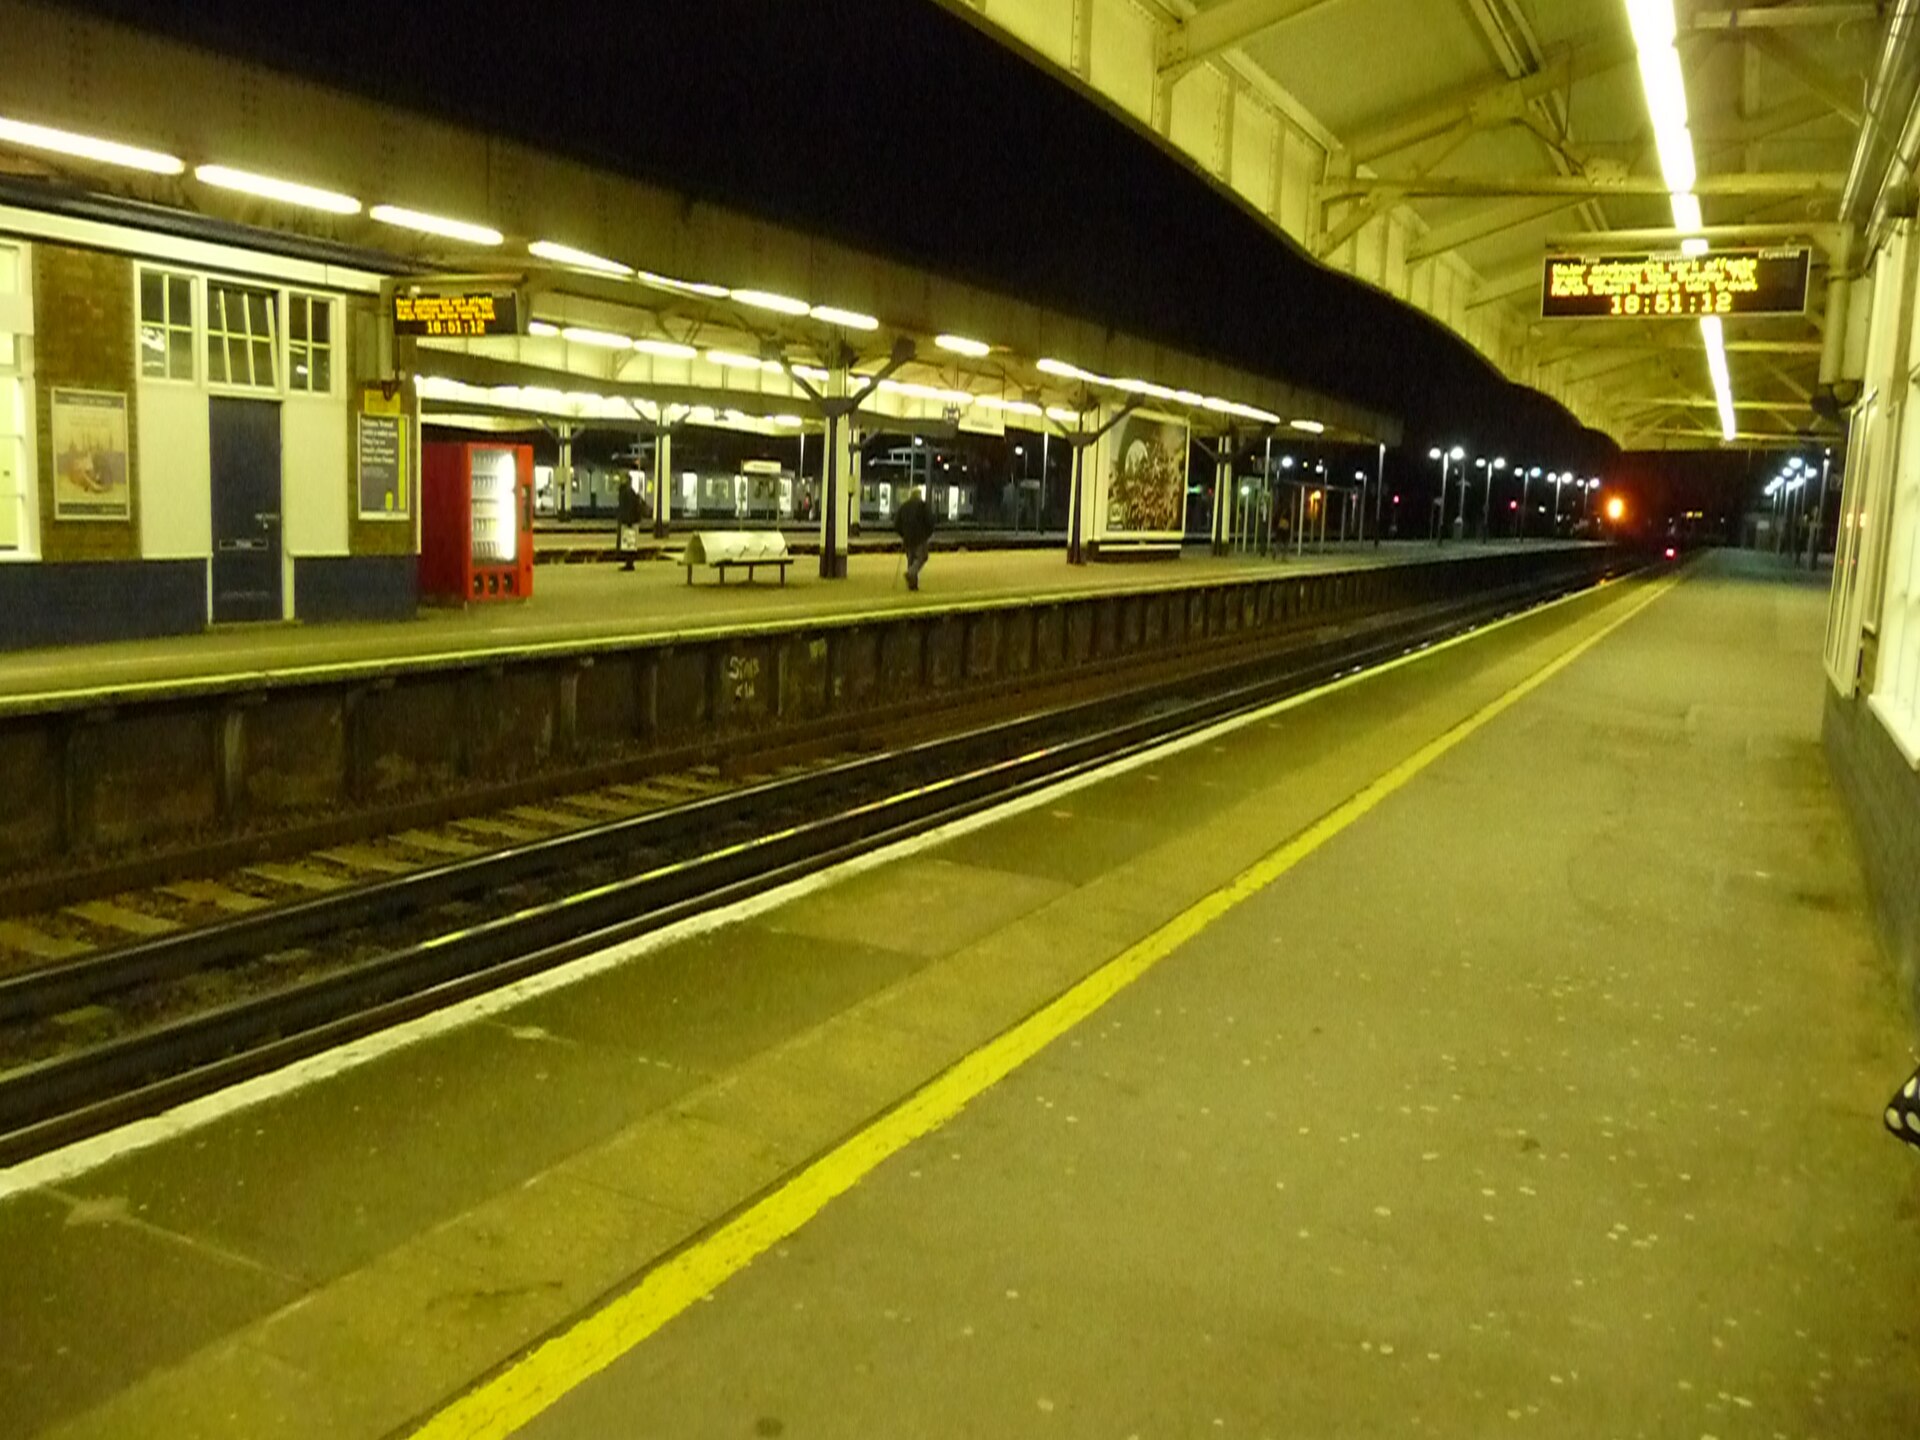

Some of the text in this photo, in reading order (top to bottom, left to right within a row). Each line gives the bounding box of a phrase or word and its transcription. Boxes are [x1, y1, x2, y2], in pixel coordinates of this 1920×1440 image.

[1552, 263, 1587, 276] Major
[1591, 262, 1664, 276] engineering
[1611, 291, 1732, 314] 18:51:12
